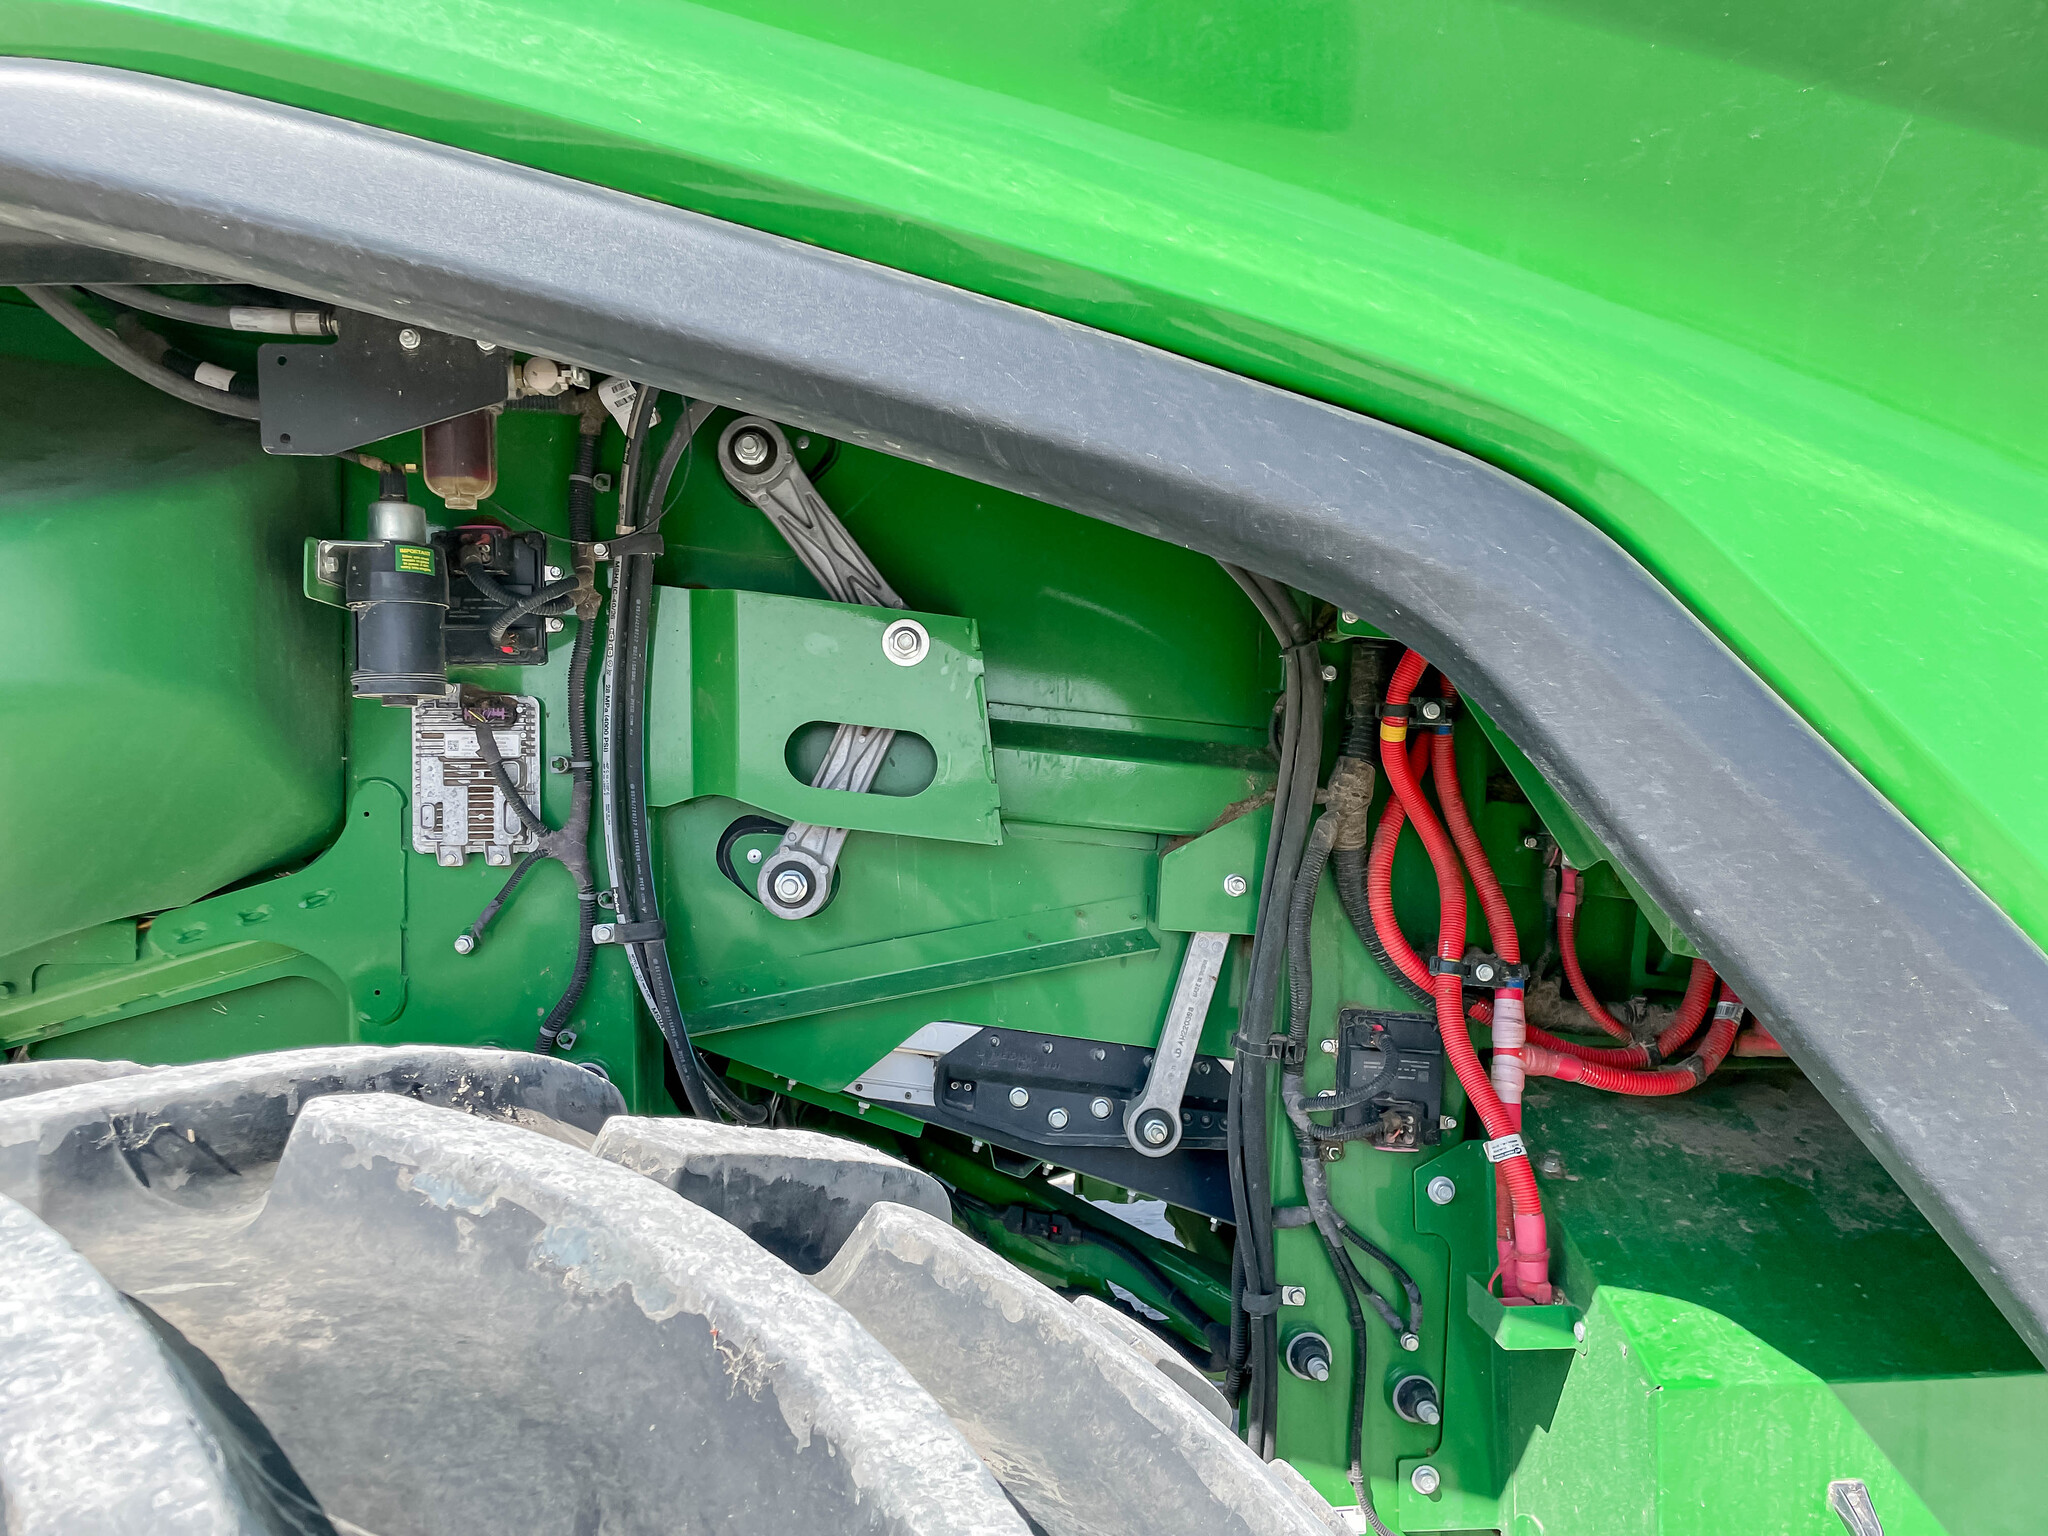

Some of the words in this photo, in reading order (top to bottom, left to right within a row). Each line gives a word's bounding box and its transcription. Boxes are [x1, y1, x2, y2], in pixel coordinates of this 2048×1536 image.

[400, 547, 431, 556] IMPORTANT
[613, 561, 621, 585] MSHA
[605, 684, 611, 694] 28
